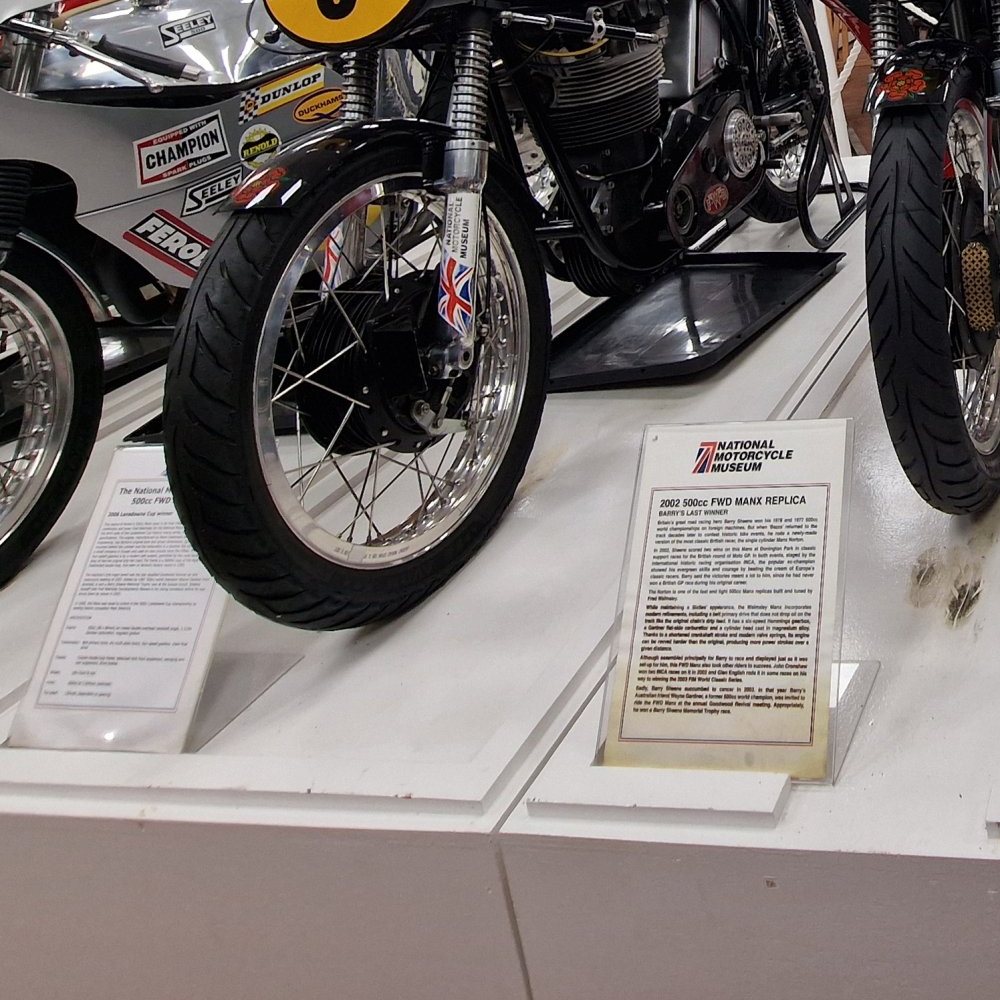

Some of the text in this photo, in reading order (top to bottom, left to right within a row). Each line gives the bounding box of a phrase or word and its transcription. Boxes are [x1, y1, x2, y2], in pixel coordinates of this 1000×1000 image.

[160, 14, 214, 47] SEELEY
[259, 72, 322, 105] DUNLOP
[297, 93, 345, 117] DUCKHAMS
[152, 119, 207, 146] EQUIPPED WITH
[145, 127, 220, 170] CHAMPION
[242, 137, 279, 158] RENOLD
[162, 154, 212, 179] SPARK PLUGS
[185, 174, 241, 213] SEELEY
[446, 202, 454, 246] NATIONAL
[451, 196, 463, 253] MOTORCYCLE
[460, 218, 470, 259] MUSEUM
[714, 450, 793, 461] MOTORCYCLE
[717, 440, 775, 450] NATIONAL
[711, 462, 762, 473] MUSEUM
[120, 487, 132, 495] The
[133, 486, 163, 495] National
[131, 496, 171, 505] 500cc FWD
[660, 495, 806, 508] 2002 500cc FWD MANX REPLICA
